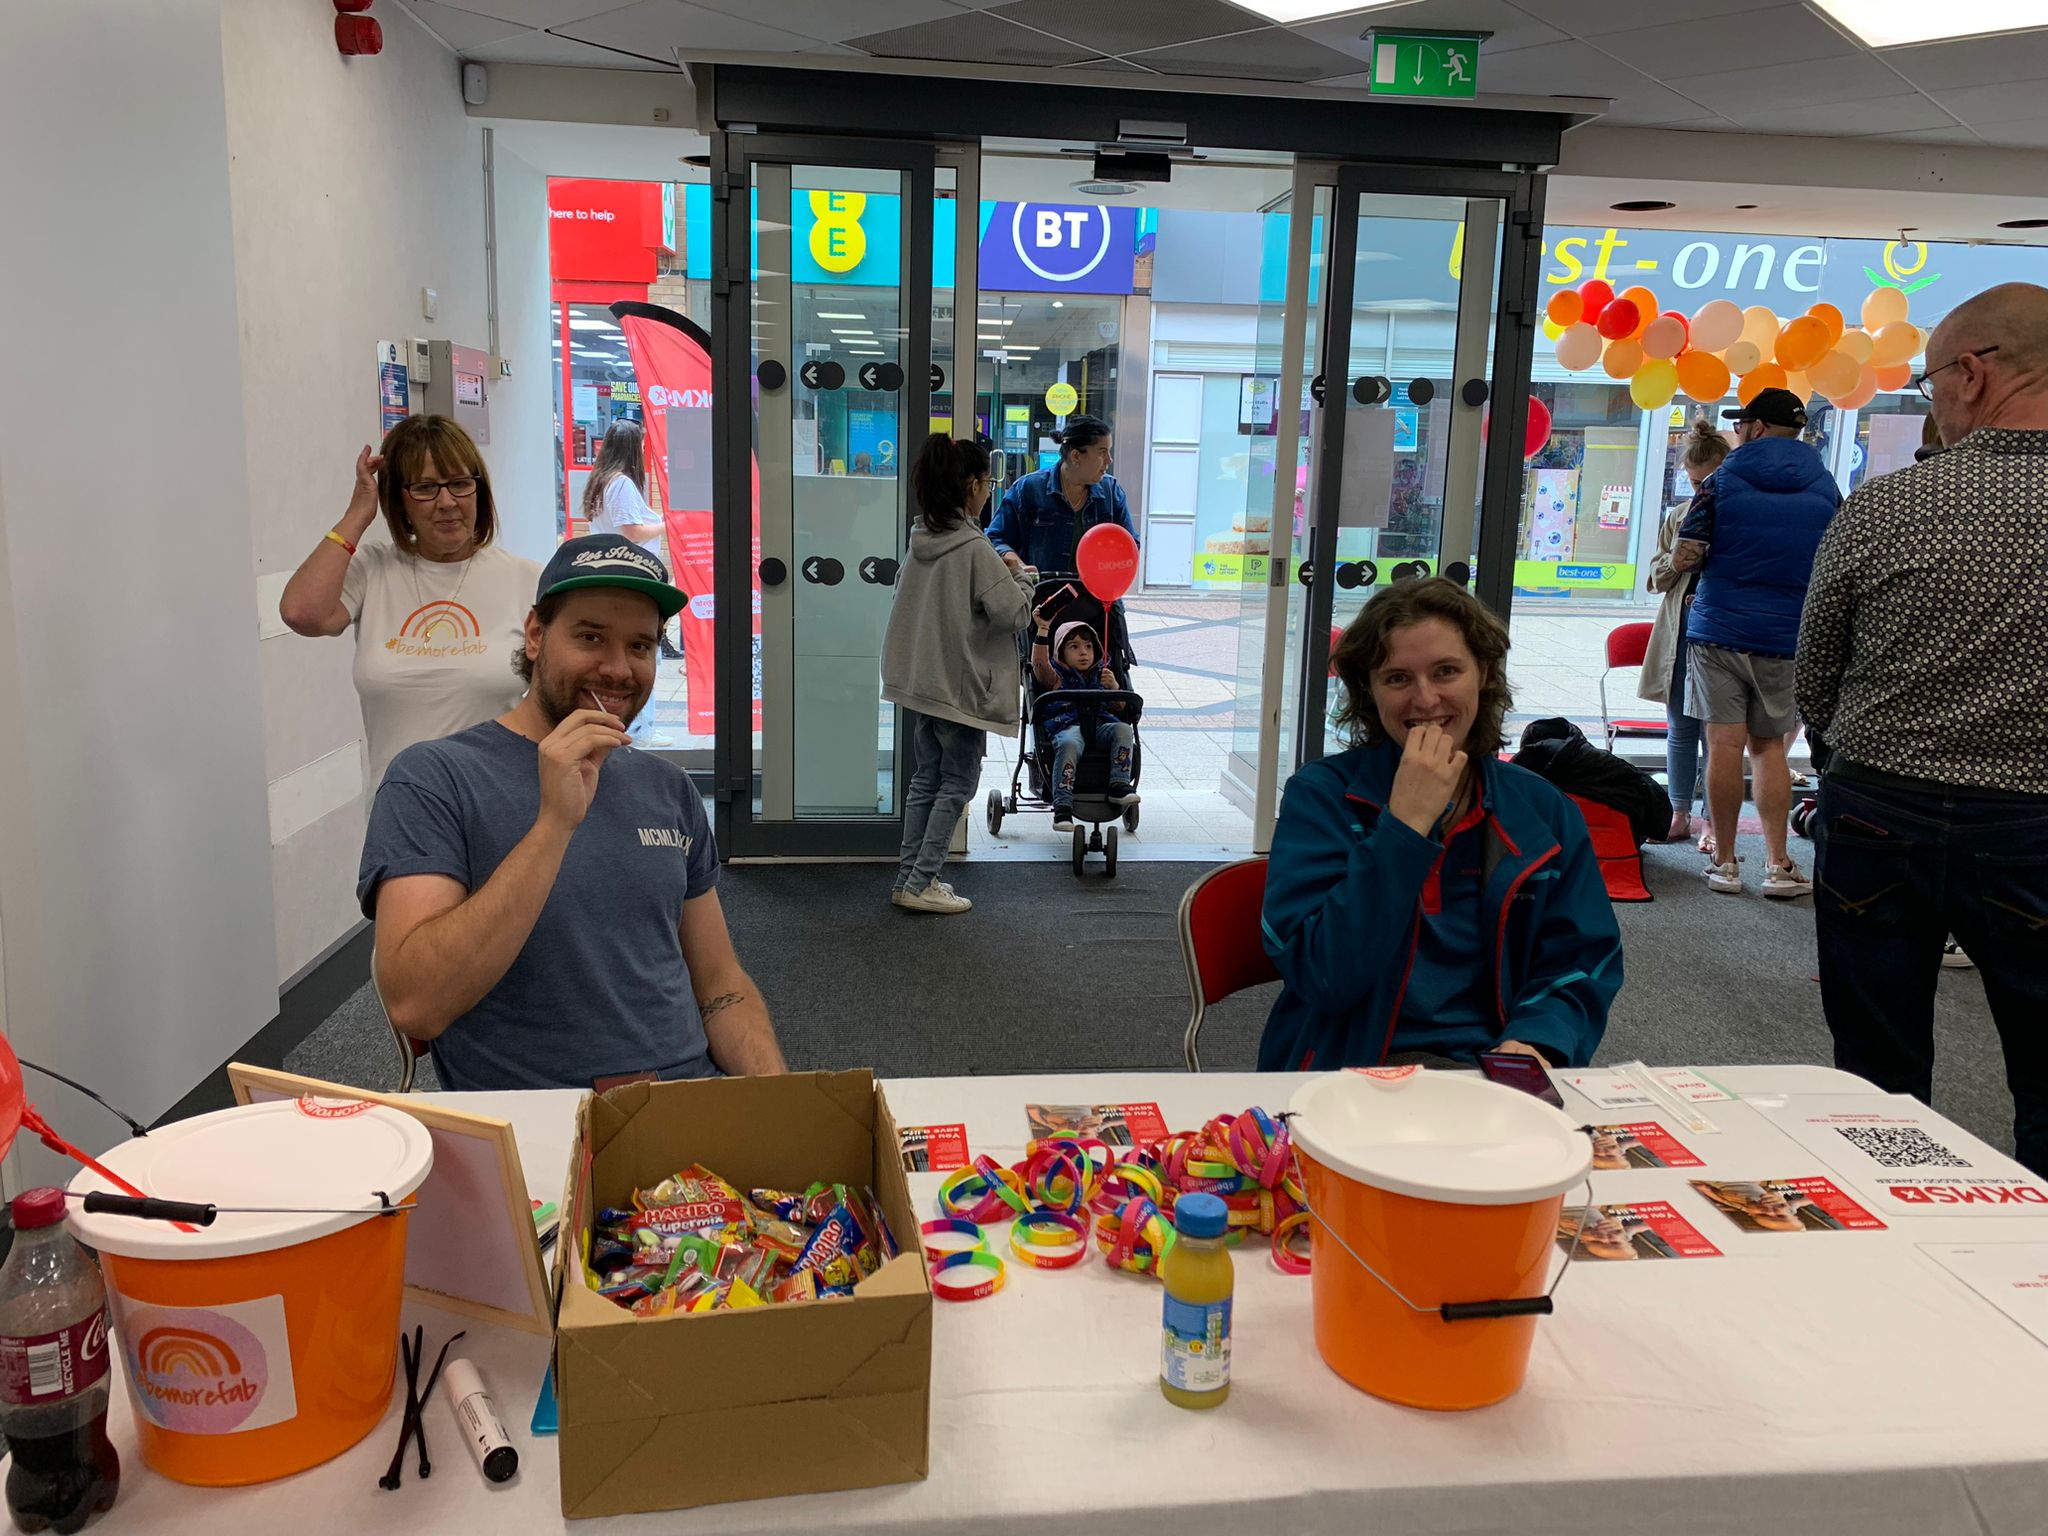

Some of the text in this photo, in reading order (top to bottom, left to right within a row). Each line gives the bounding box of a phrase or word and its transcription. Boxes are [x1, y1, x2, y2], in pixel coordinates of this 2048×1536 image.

[549, 207, 615, 222] here to help
[1036, 210, 1089, 249] BT
[1448, 221, 1828, 292] st-one
[1558, 568, 1599, 578] best-one
[1924, 1186, 2048, 1204] DKMS
[644, 1202, 726, 1224] HARIBO
[651, 1215, 724, 1234] Supermix
[59, 1329, 74, 1395] RECYCLE ME
